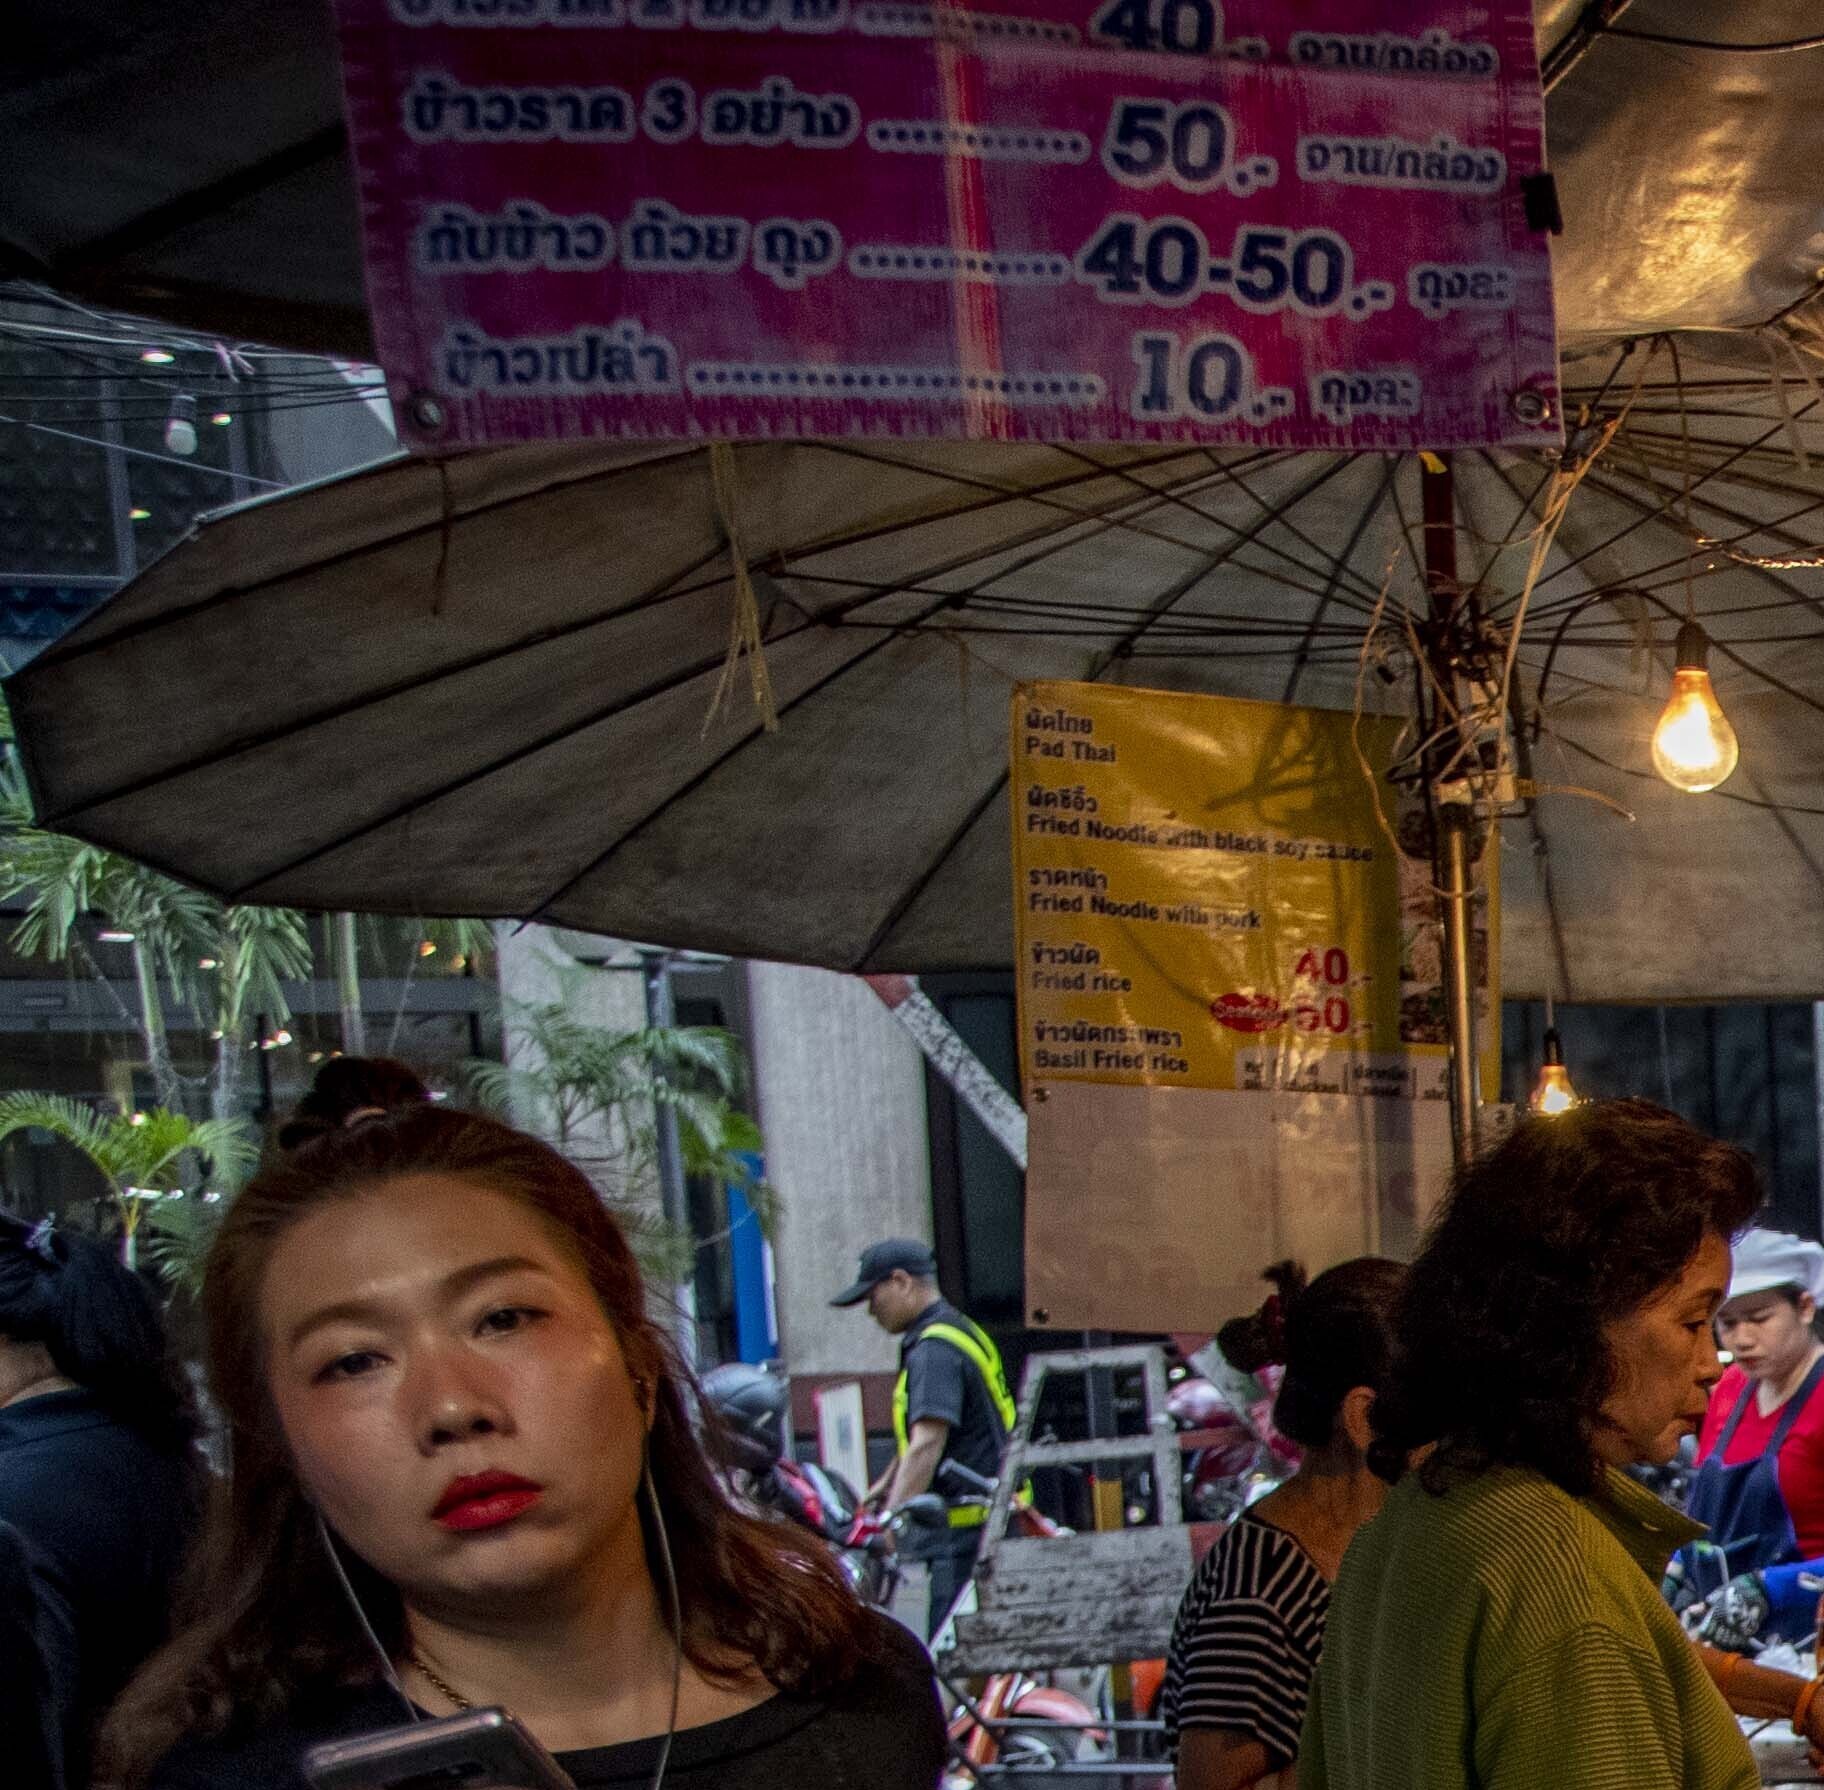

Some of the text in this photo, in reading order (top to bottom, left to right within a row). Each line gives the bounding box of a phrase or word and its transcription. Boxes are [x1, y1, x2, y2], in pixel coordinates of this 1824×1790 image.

[410, 81, 1500, 187] ข้าวราด 3 อย่าง 50.- จาน/กล่อง
[426, 208, 1508, 312] กับข้าว ถ้วย ถุง 40-50.- ถุงละ
[445, 328, 1412, 415] ข้าวเปล่า 10.- ถุงละ
[1026, 735, 1116, 763] Pad Thai
[1028, 814, 1080, 836] Fried
[1086, 819, 1158, 845] Noodle
[1215, 831, 1267, 854] black
[1274, 840, 1309, 862] soy
[1029, 867, 1107, 890] ราดหน้า
[1030, 893, 1082, 914] Fried
[1090, 896, 1159, 921] Noodle
[1216, 909, 1261, 930] pork
[1032, 972, 1133, 993] Fried rice
[1034, 1048, 1086, 1069] Basil
[1152, 1052, 1190, 1073] rice
